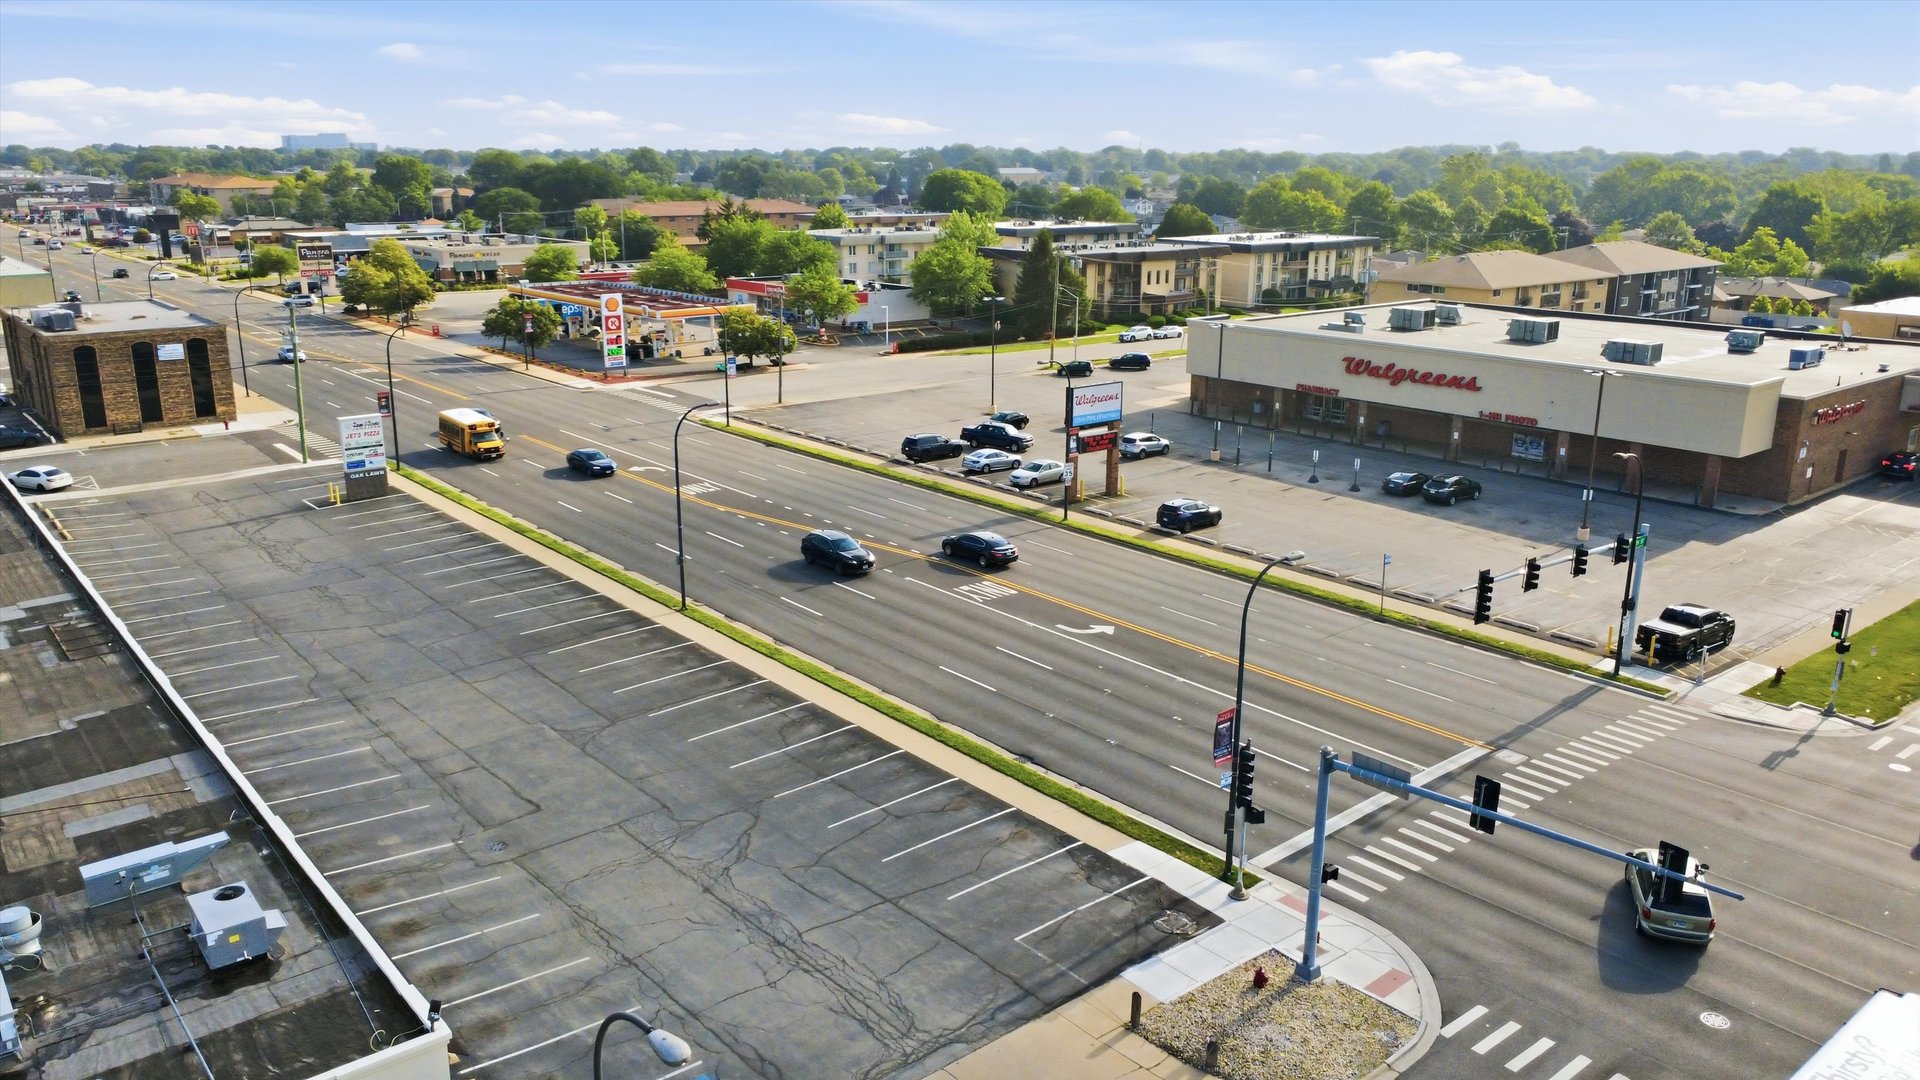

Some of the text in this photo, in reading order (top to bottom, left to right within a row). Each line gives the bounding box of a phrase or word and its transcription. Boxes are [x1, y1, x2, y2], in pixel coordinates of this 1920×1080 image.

[561, 304, 583, 315] epsi
[1342, 357, 1482, 391] Walgreens
[1296, 383, 1340, 397] PHARMACY
[1075, 393, 1120, 407] Walgreens
